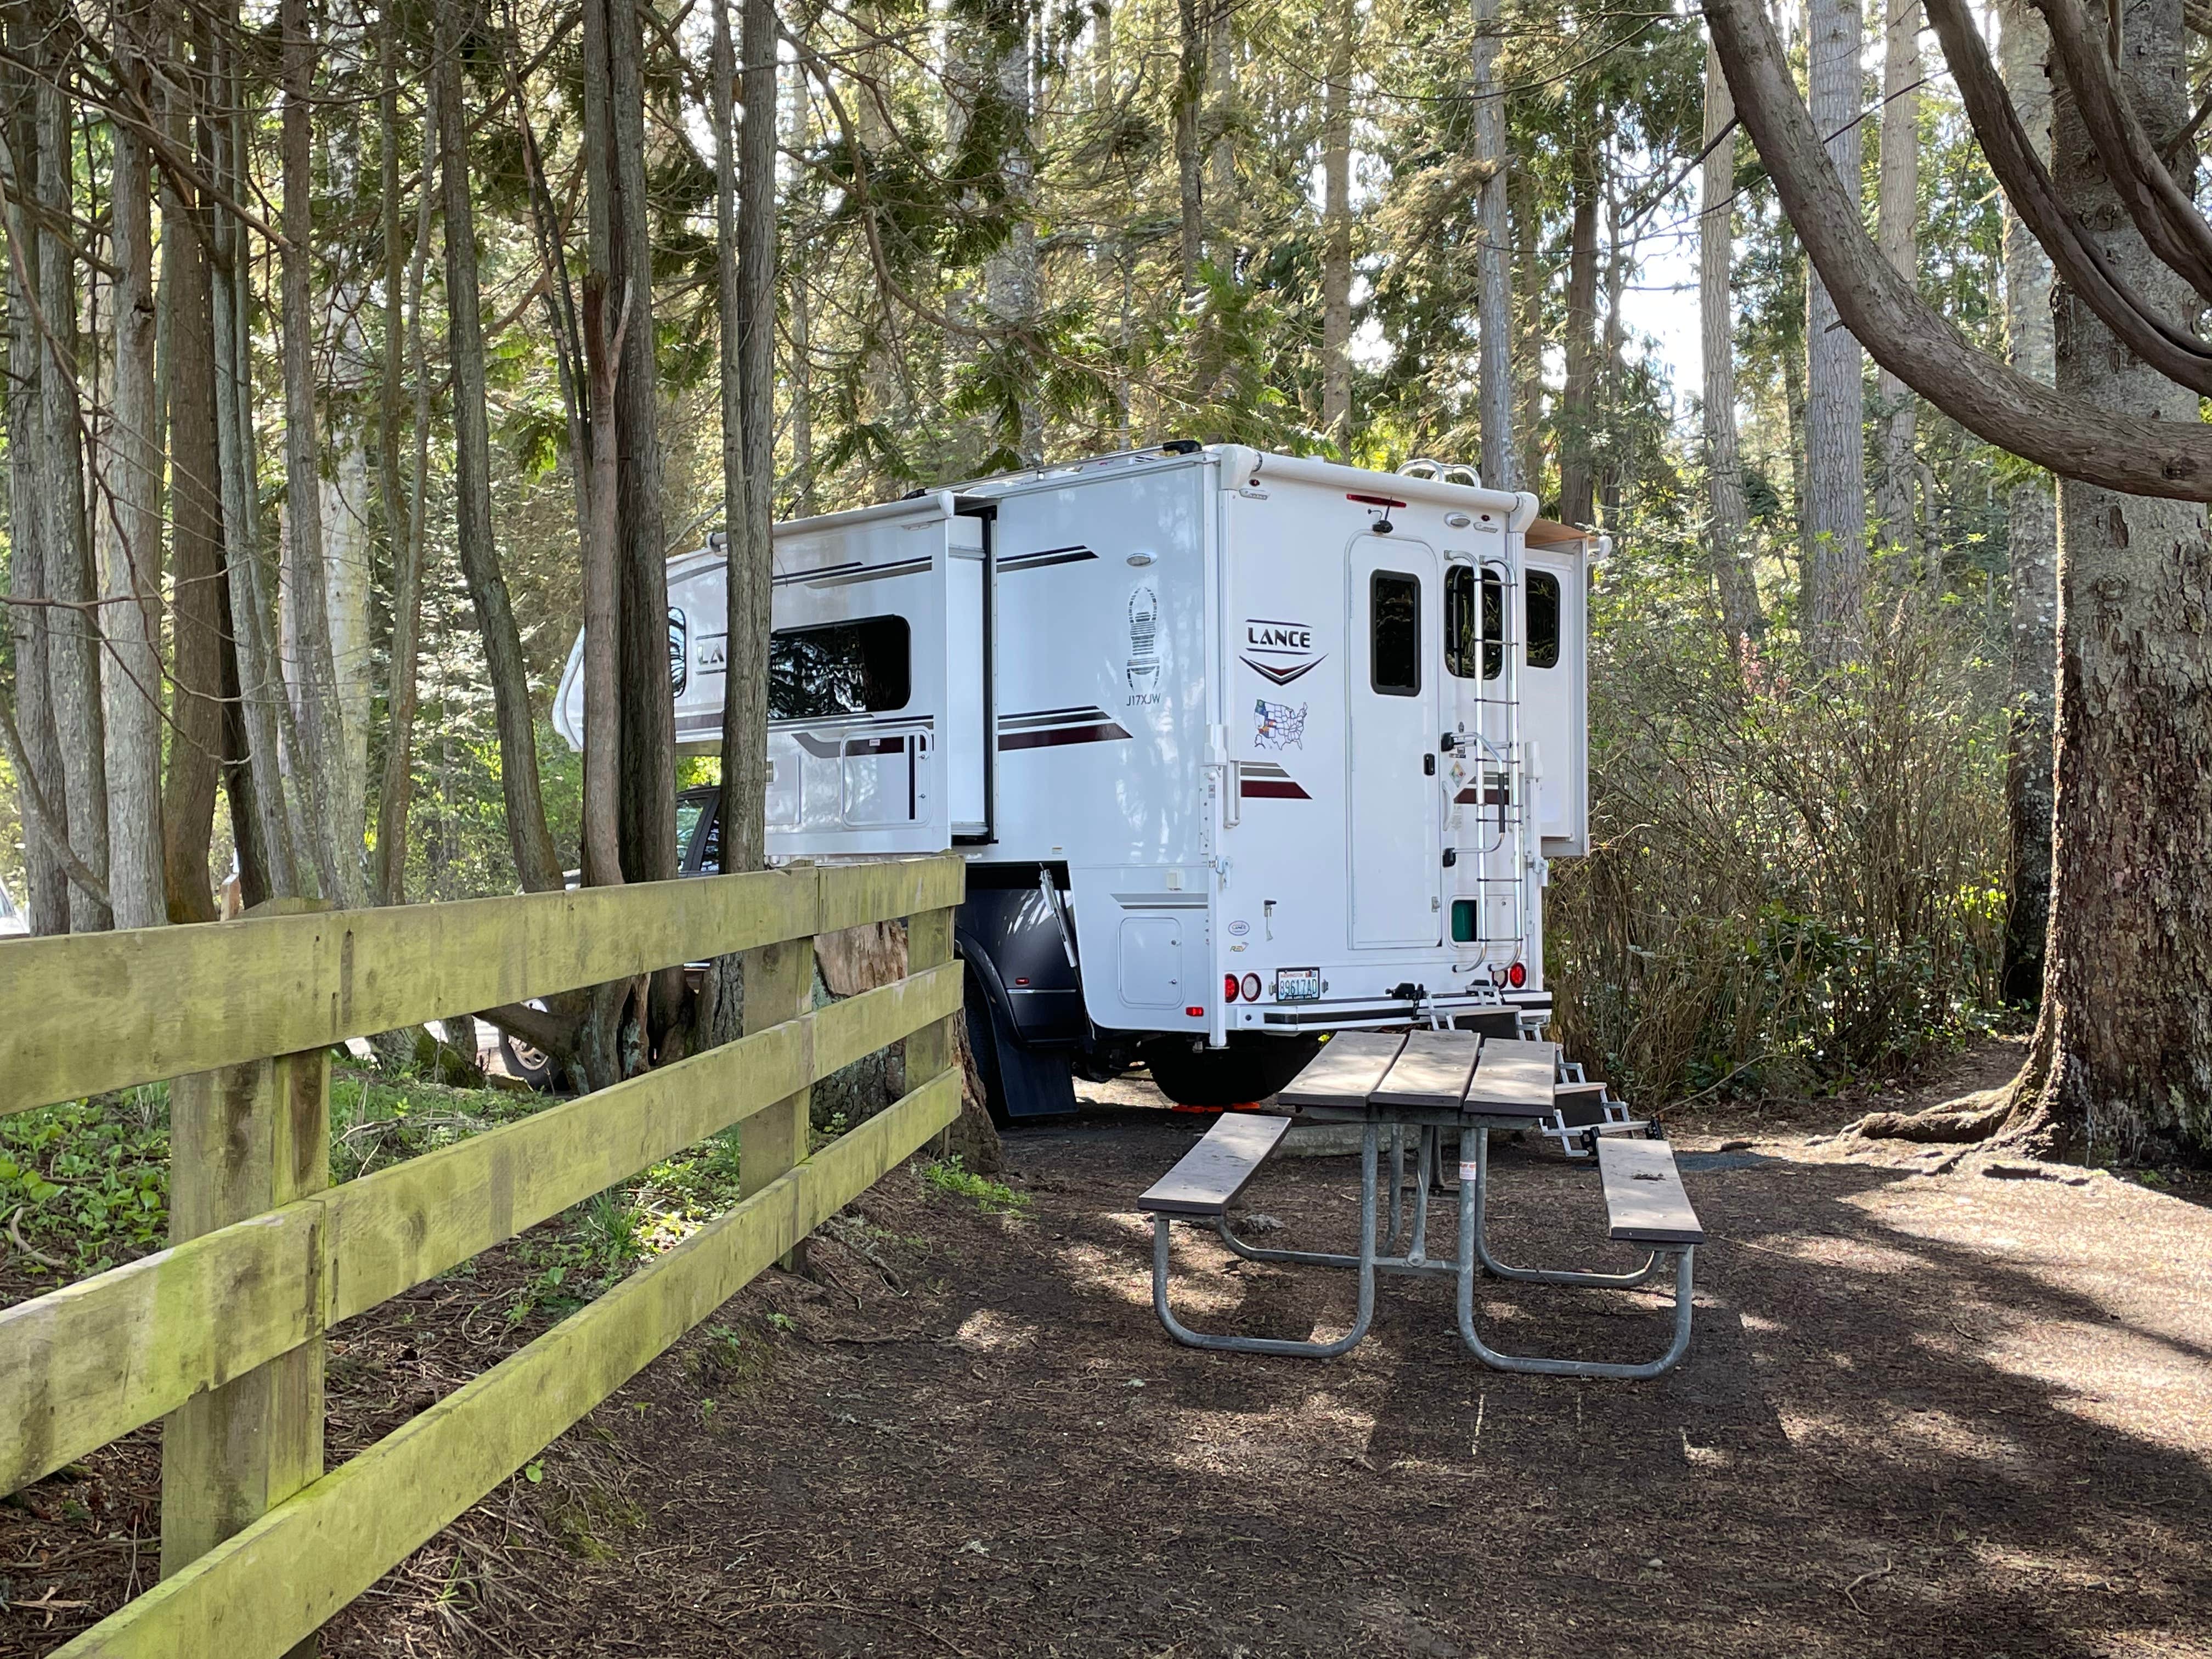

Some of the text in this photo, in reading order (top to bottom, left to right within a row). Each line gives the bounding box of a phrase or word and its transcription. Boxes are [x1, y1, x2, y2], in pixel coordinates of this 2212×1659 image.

[1248, 627, 1310, 648] LANCE
[1126, 693, 1161, 706] J17XJW
[1280, 979, 1317, 996] 89617AD
